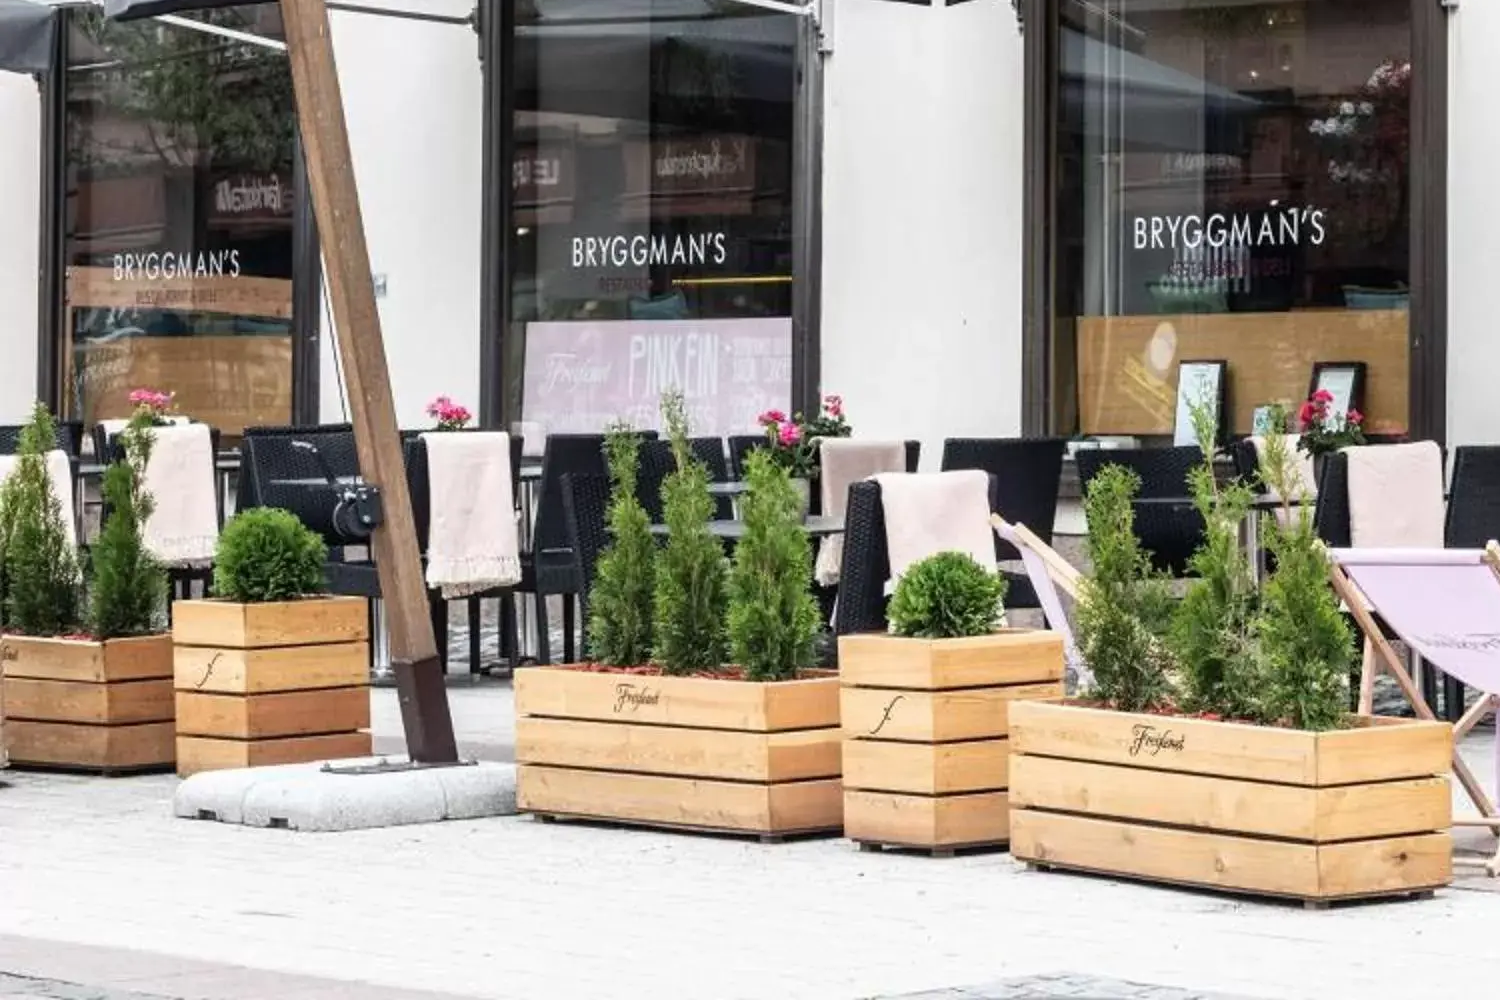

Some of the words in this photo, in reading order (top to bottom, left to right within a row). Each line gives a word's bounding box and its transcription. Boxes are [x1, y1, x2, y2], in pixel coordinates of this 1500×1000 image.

[1133, 210, 1326, 250] BRYGGMAN'S
[112, 249, 241, 281] BRYGGMAN'S
[572, 232, 726, 267] BRYGGMAN'S
